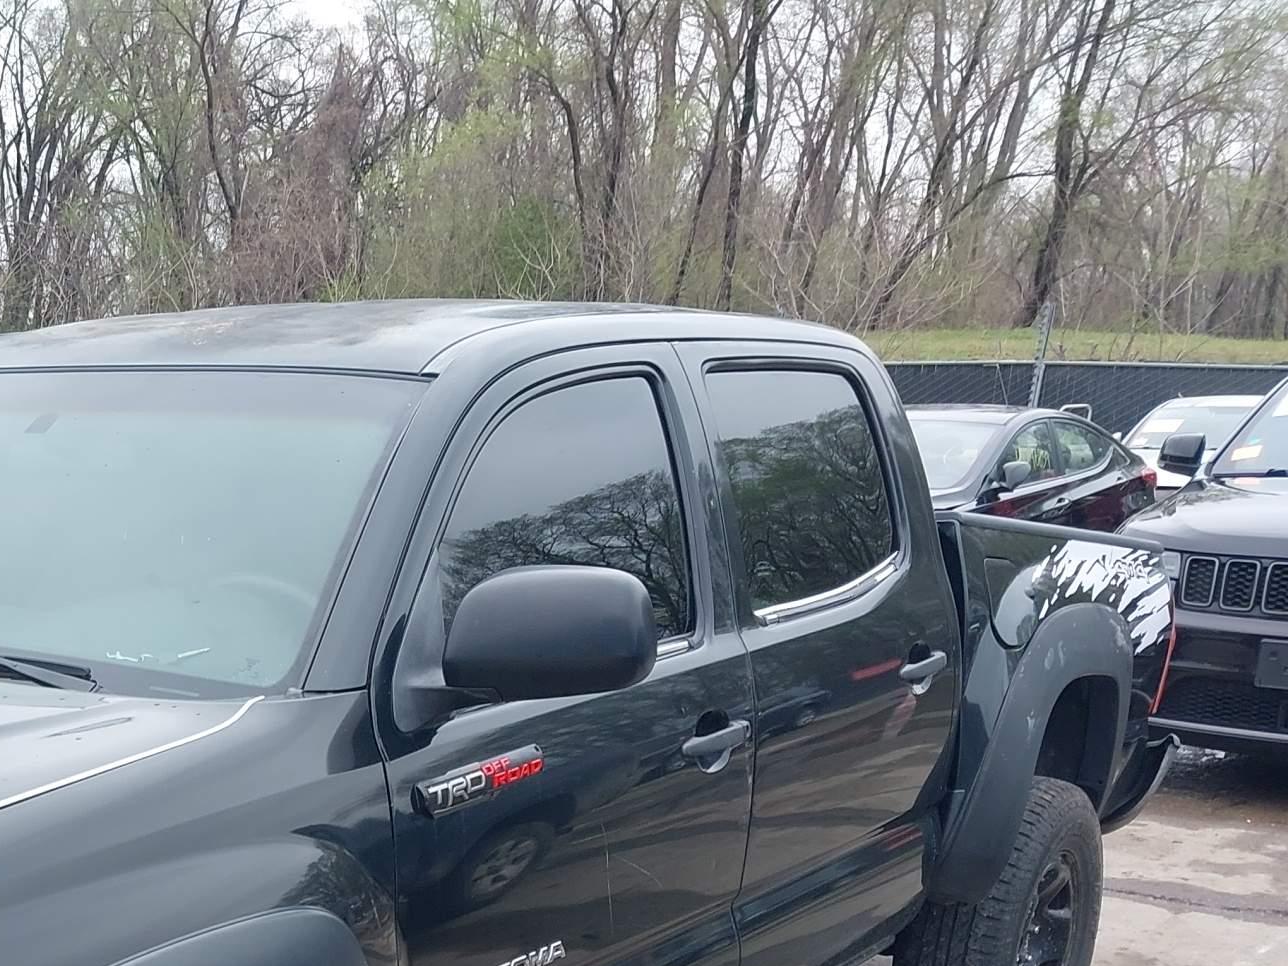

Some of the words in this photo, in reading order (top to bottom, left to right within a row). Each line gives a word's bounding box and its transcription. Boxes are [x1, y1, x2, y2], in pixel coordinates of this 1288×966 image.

[481, 757, 511, 777] OFF
[492, 758, 545, 789] ROAD
[427, 770, 487, 807] TRD
